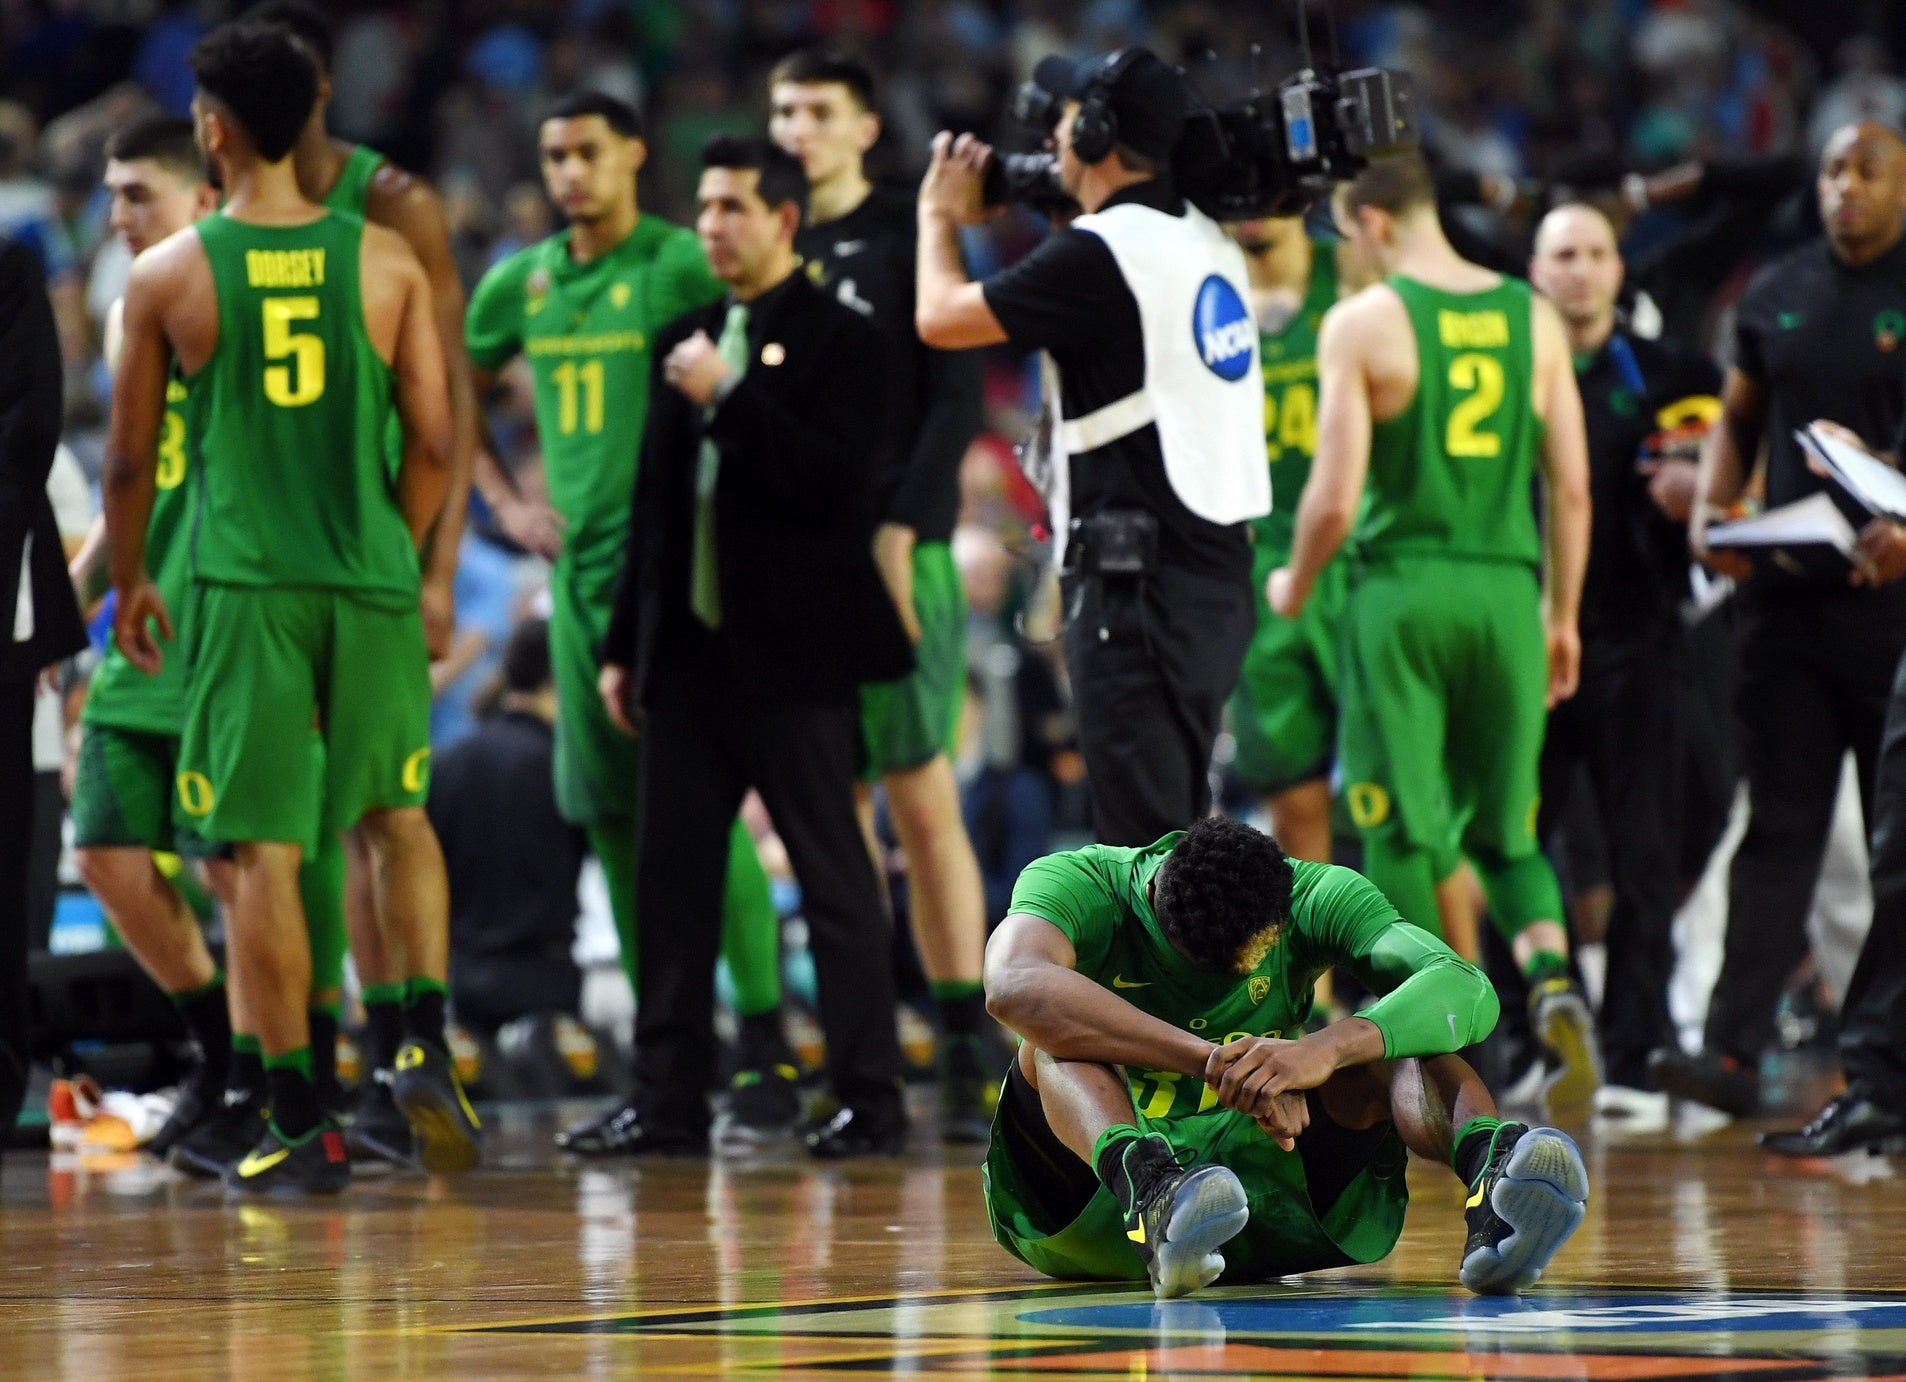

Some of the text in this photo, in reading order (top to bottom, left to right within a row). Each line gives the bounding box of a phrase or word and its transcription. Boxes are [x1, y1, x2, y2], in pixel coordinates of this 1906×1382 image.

[262, 296, 325, 408] 5
[551, 360, 605, 435] 11
[1446, 352, 1504, 458] 2
[177, 770, 215, 817] O
[1347, 781, 1390, 829] O
[1189, 1018, 1207, 1030] O
